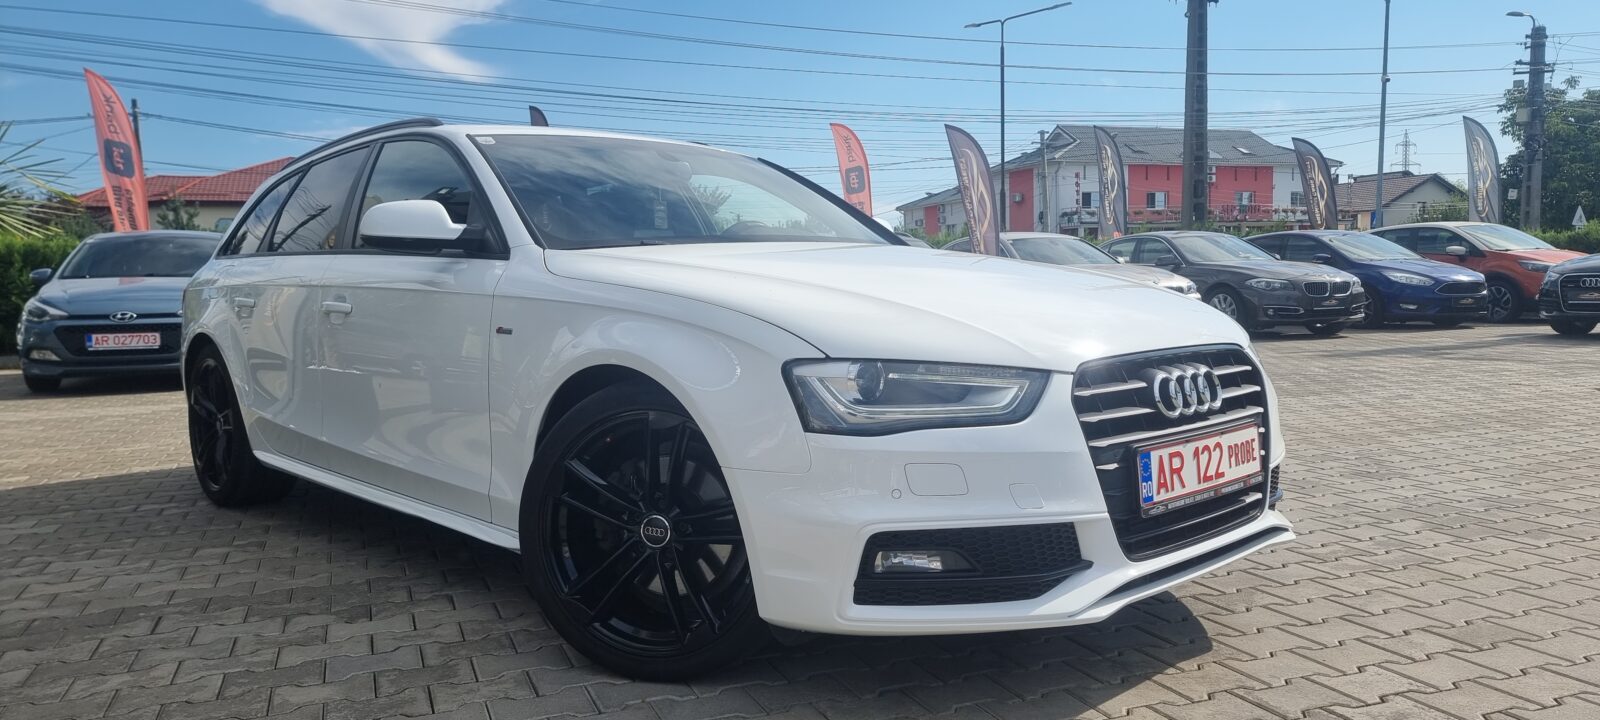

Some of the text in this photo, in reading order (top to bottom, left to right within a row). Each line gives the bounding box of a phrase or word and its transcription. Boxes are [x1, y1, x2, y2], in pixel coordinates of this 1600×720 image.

[94, 334, 158, 346] AR 027703
[1156, 438, 1257, 496] AR 122 PROBE
[1142, 481, 1154, 499] RO
